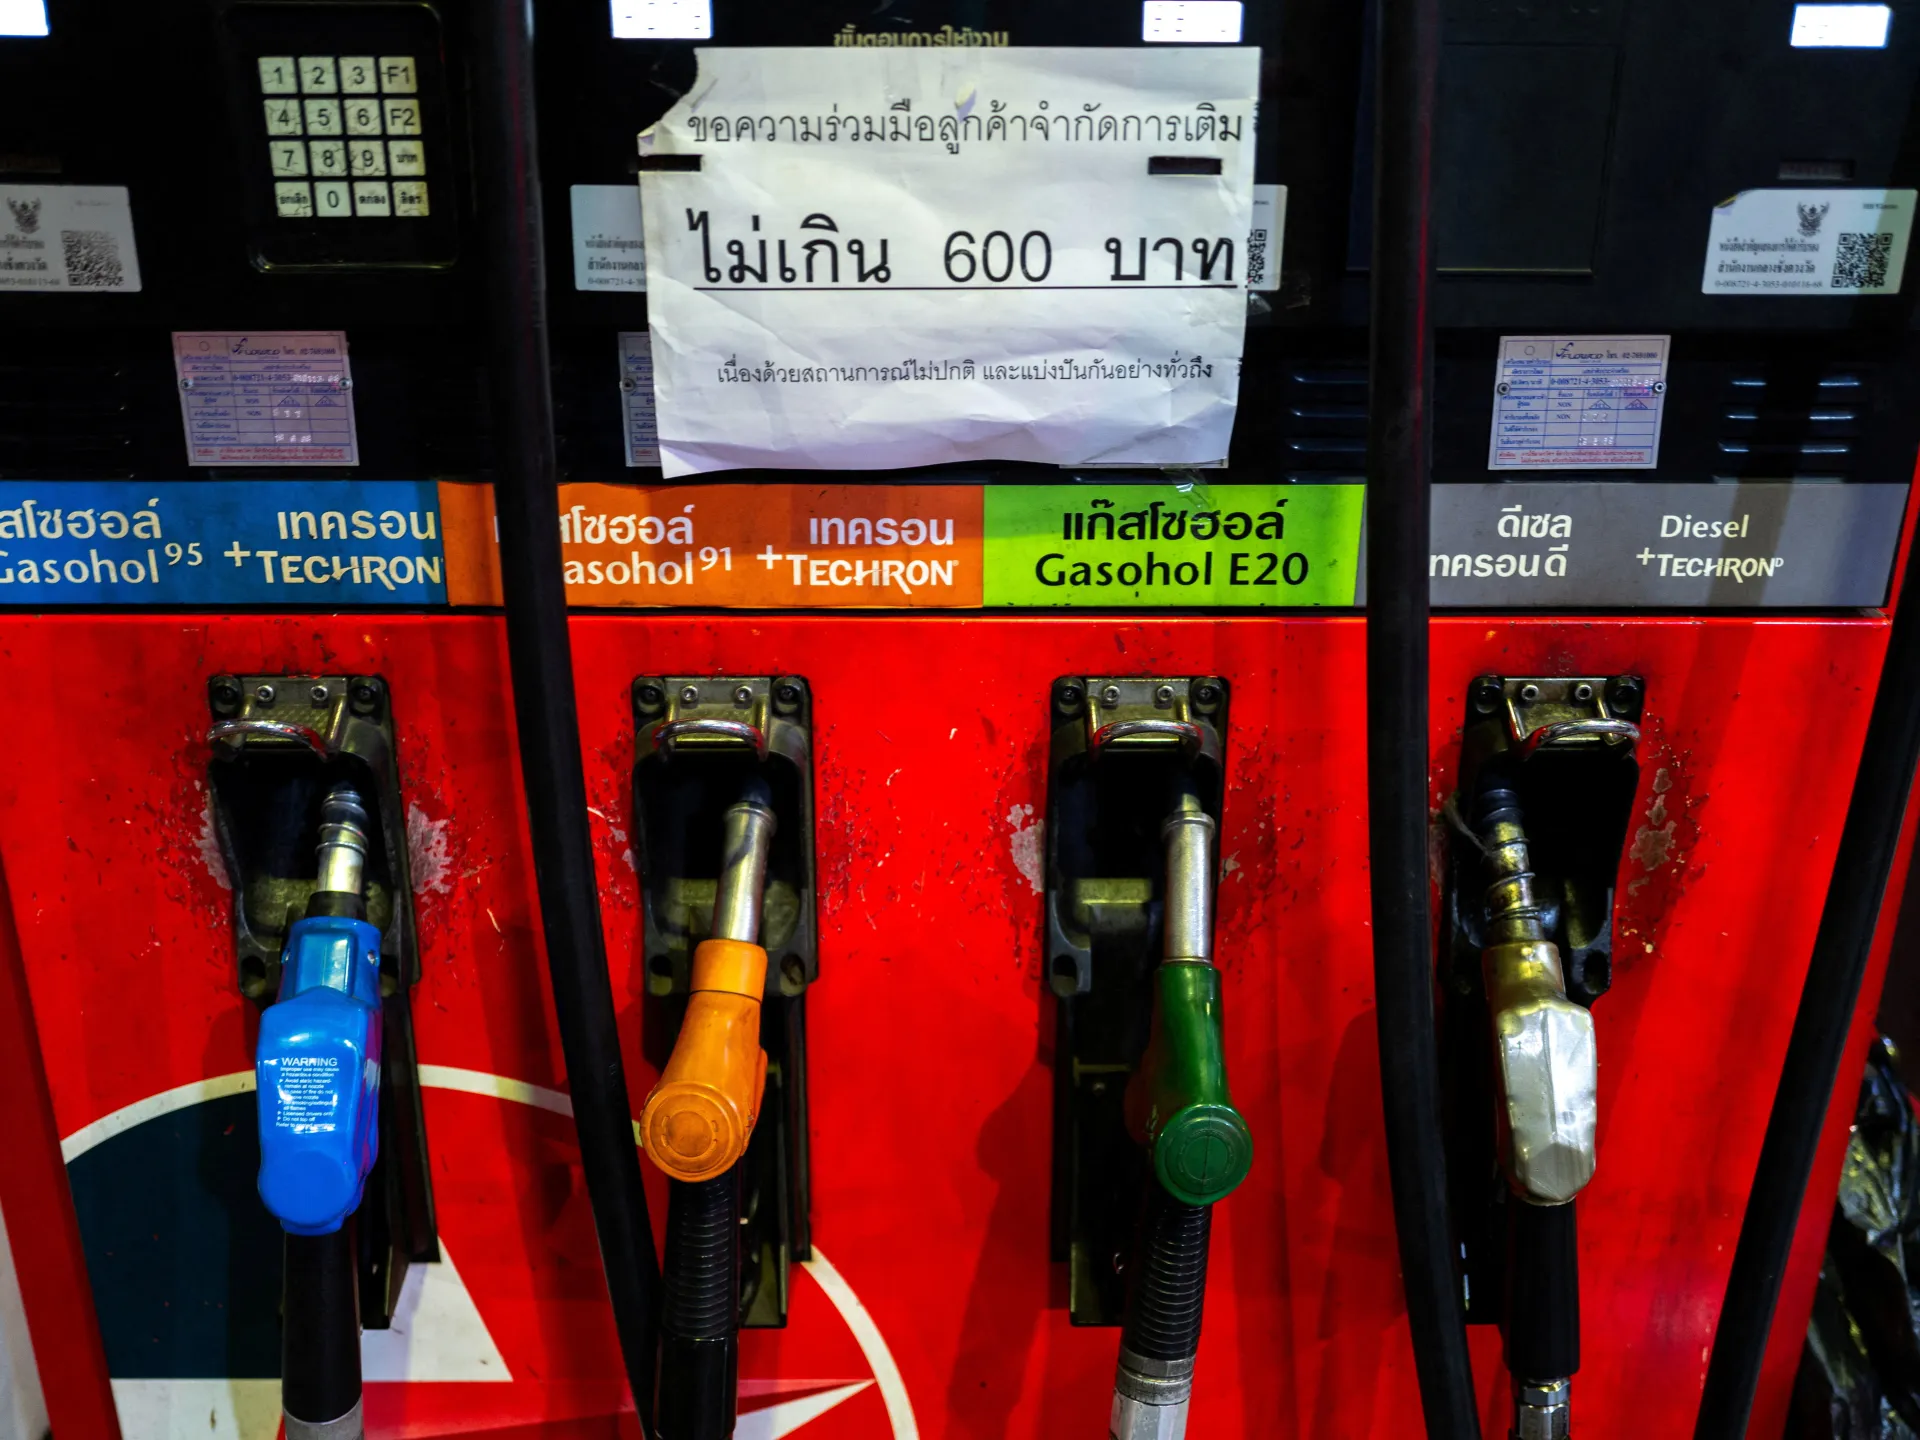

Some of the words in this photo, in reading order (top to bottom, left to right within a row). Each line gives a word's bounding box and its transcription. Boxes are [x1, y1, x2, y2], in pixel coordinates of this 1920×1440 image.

[274, 66, 283, 85] 1
[312, 66, 325, 85] 2
[352, 66, 365, 85] 3
[388, 66, 410, 84] F1
[278, 109, 290, 126] 4
[318, 108, 330, 126] 5
[358, 108, 370, 126] 6
[391, 108, 415, 126] F2
[687, 98, 1242, 155] ขอความร่วมมือลูกค้าจำกัดการเติม
[283, 150, 295, 167] 7
[323, 150, 334, 168] 8
[363, 149, 374, 167] 9
[327, 190, 339, 208] 0
[686, 208, 891, 283] ไม่เกิน
[944, 230, 1052, 282] 600
[1105, 237, 1235, 281] บาท
[718, 354, 975, 383] เนื่องด้วยสถานการณ์ไม่ปกติ
[983, 351, 1212, 380] และแบ่งปันกันอย่างทั่วถึง
[277, 510, 437, 540] เทครอน
[809, 517, 954, 546] เทครอน
[1063, 498, 1288, 541] แก๊สโซฮอล์
[1497, 504, 1573, 538] ดีเซล
[1660, 514, 1749, 538] Diesel
[564, 551, 693, 585] asohol
[1035, 551, 1213, 587] Gasohol
[1229, 553, 1308, 587] E20
[1429, 554, 1541, 578] ทครอน
[281, 1057, 338, 1067] WARNING
